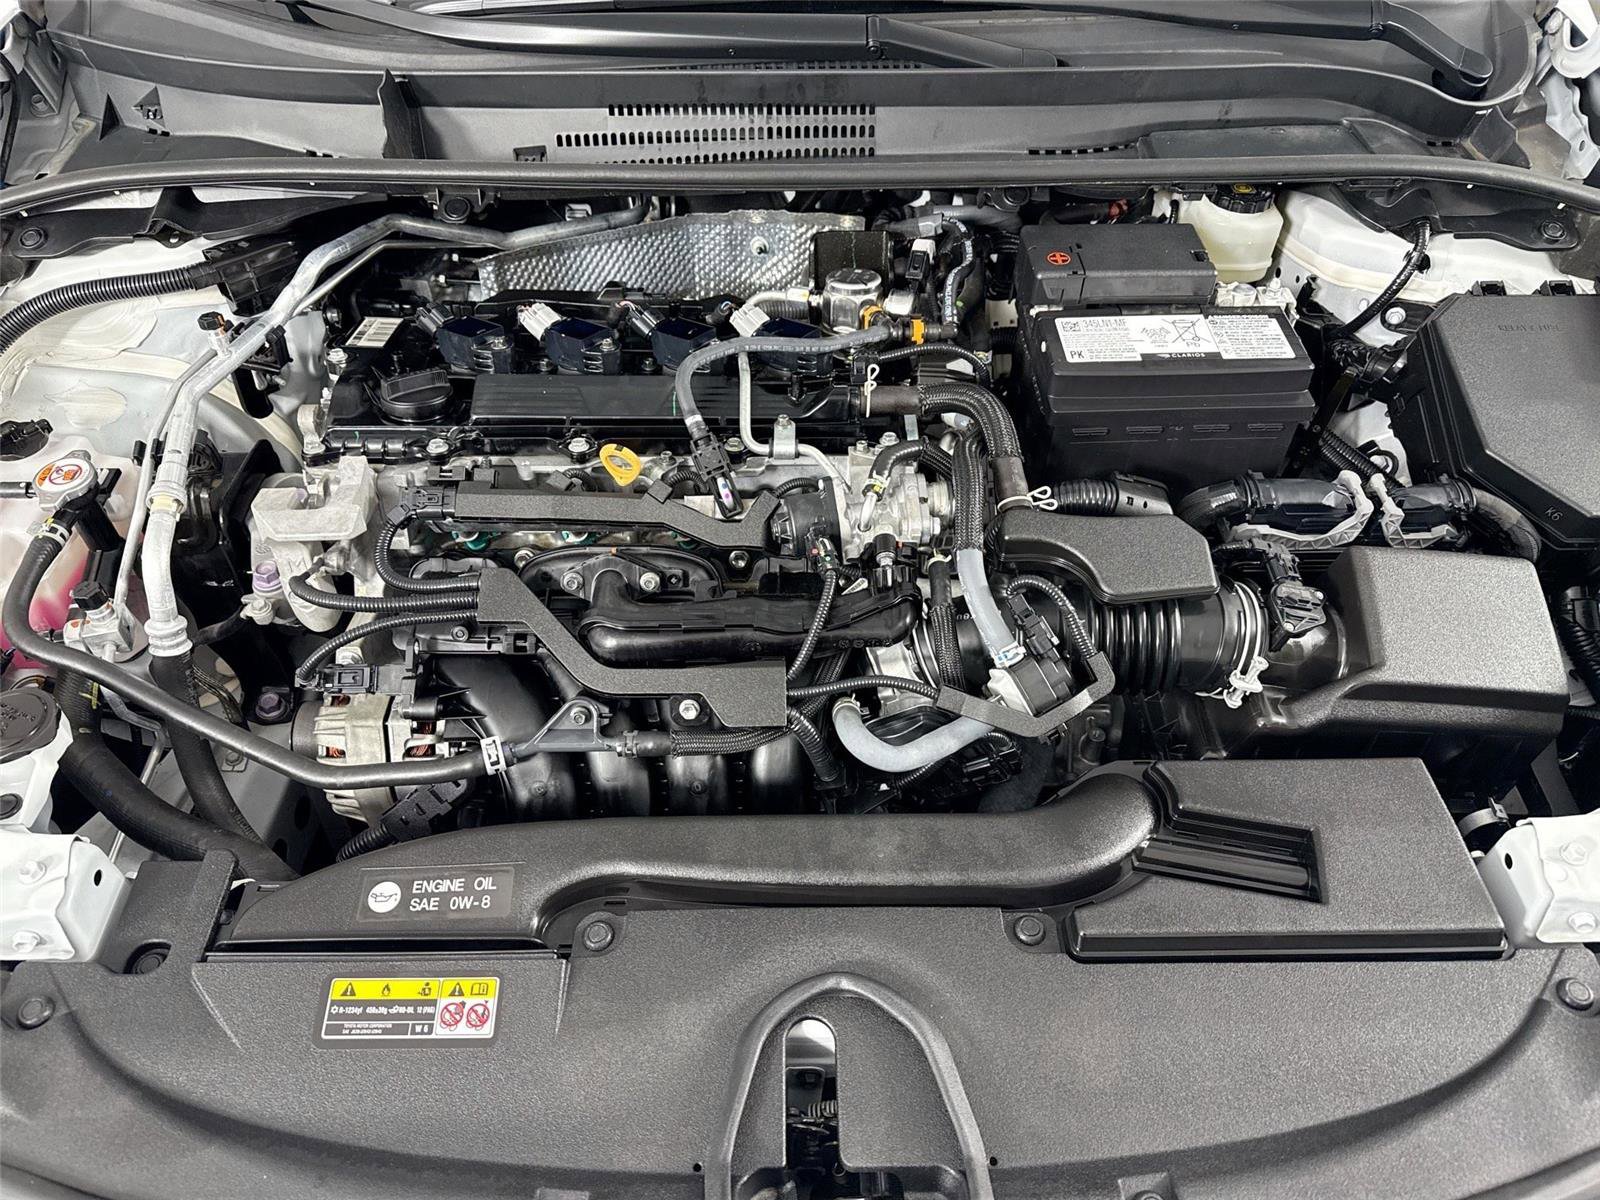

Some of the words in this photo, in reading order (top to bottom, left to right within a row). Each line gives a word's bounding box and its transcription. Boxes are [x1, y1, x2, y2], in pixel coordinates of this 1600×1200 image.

[1070, 350, 1085, 359] PK
[412, 878, 465, 893] ENGINE
[474, 877, 497, 890] OIL
[409, 898, 440, 911] SAE
[449, 895, 491, 910] 0W-8
